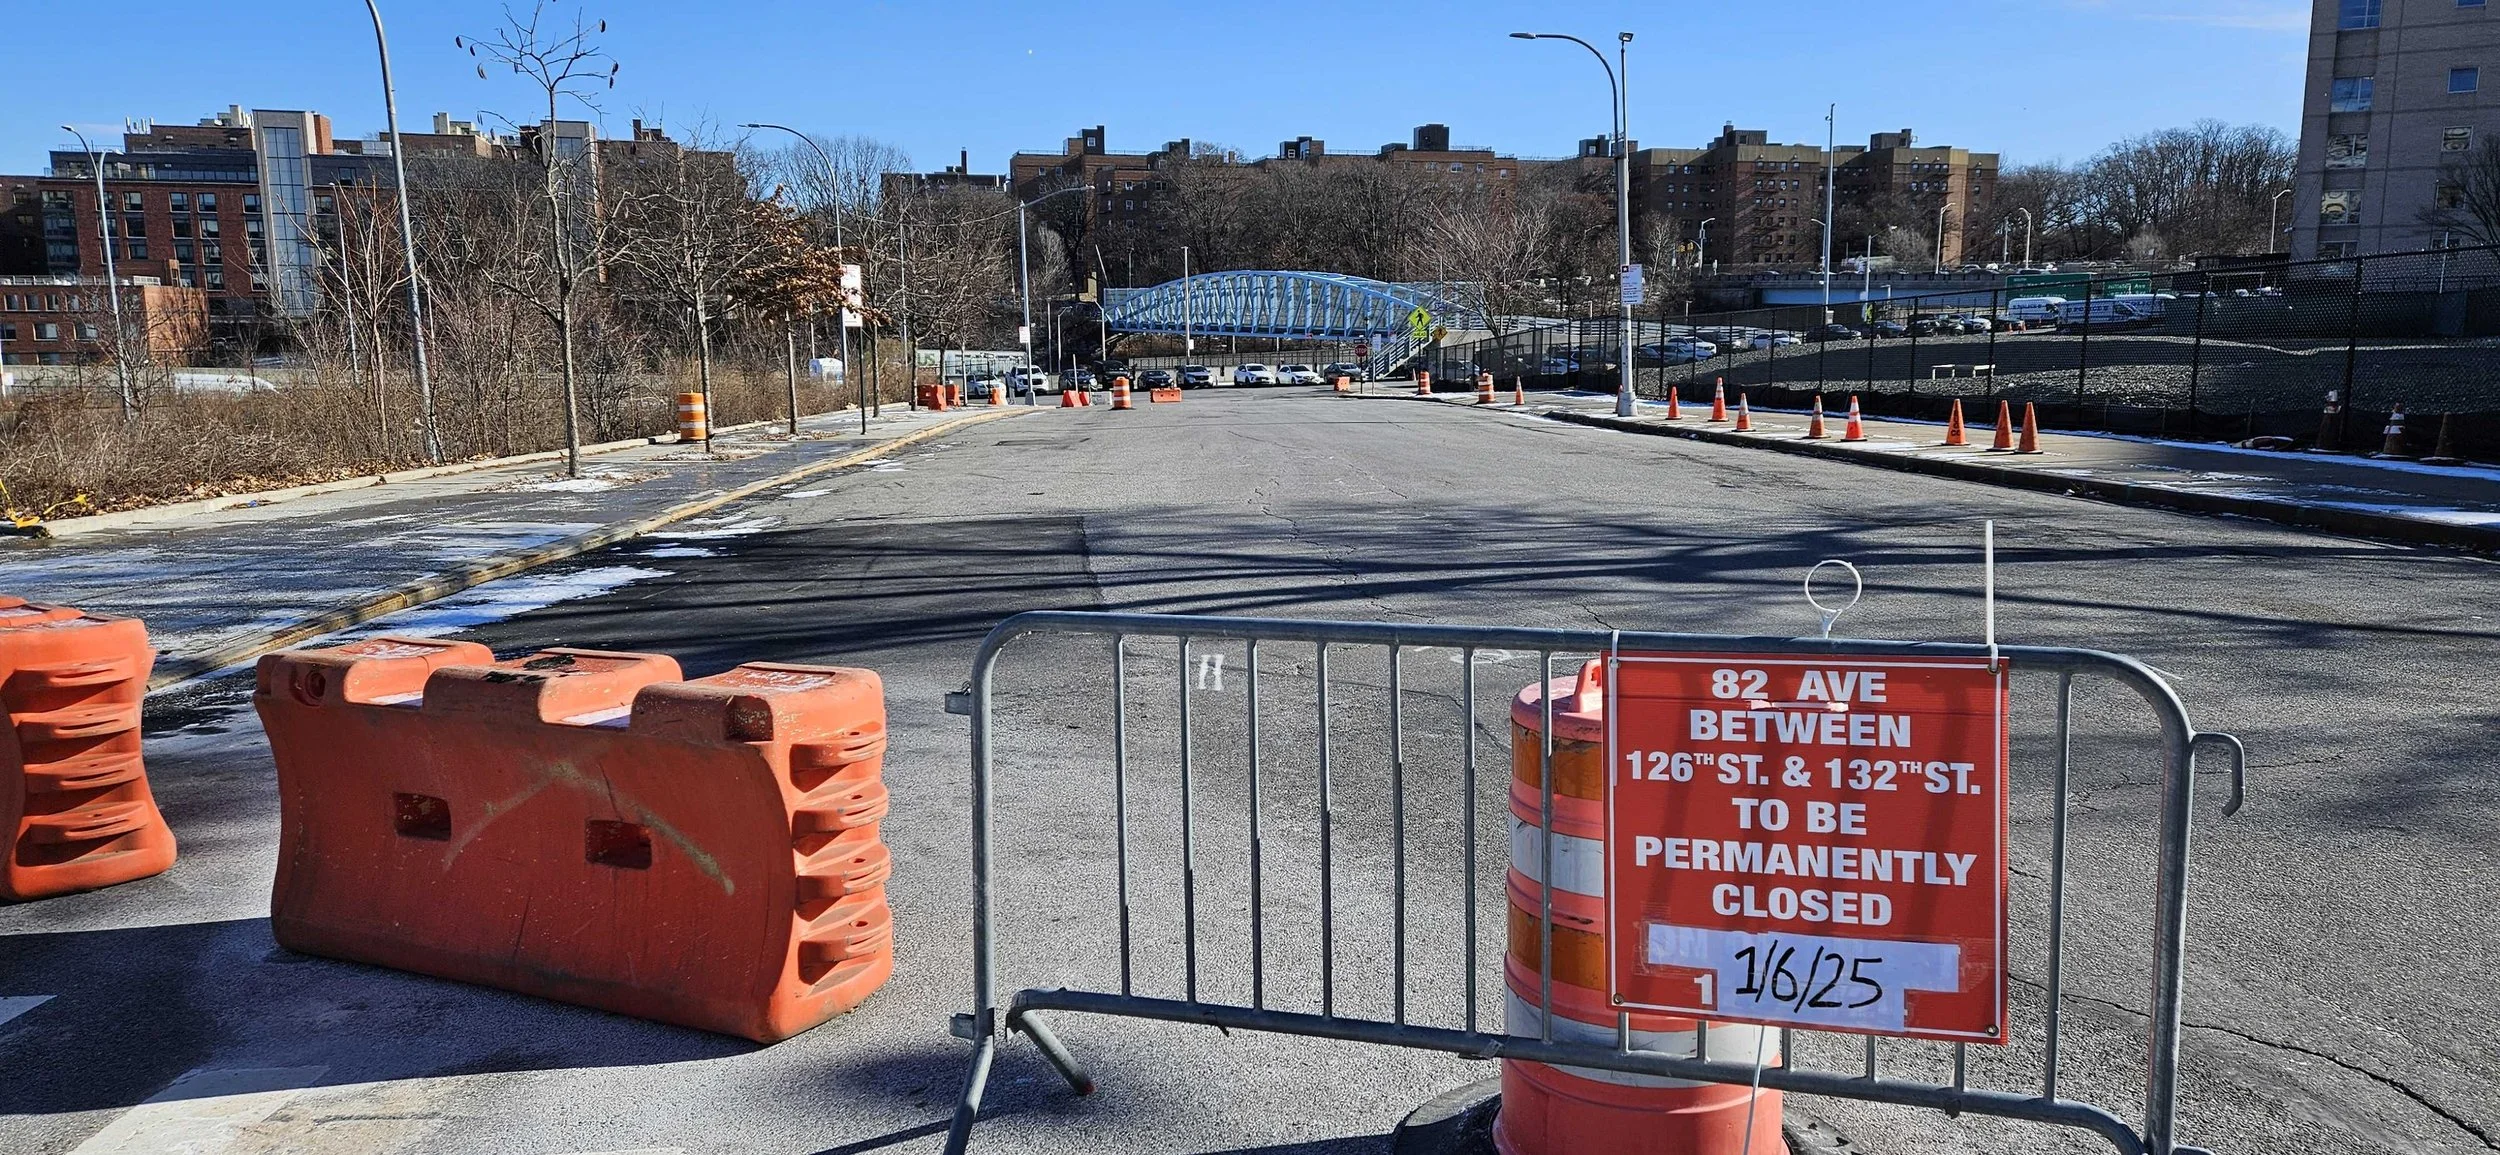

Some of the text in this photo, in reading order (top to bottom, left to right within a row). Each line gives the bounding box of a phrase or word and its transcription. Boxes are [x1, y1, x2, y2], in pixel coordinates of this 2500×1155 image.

[1711, 669, 1887, 703] 82 AVE
[1690, 709, 1911, 748] BETWEEN
[1781, 755, 1812, 788] &
[1731, 797, 1867, 836] TO BE
[1635, 835, 1978, 886] PERMANENTLY
[1712, 883, 1893, 926] CLOSED
[1734, 939, 1883, 1013] 1/6/25
